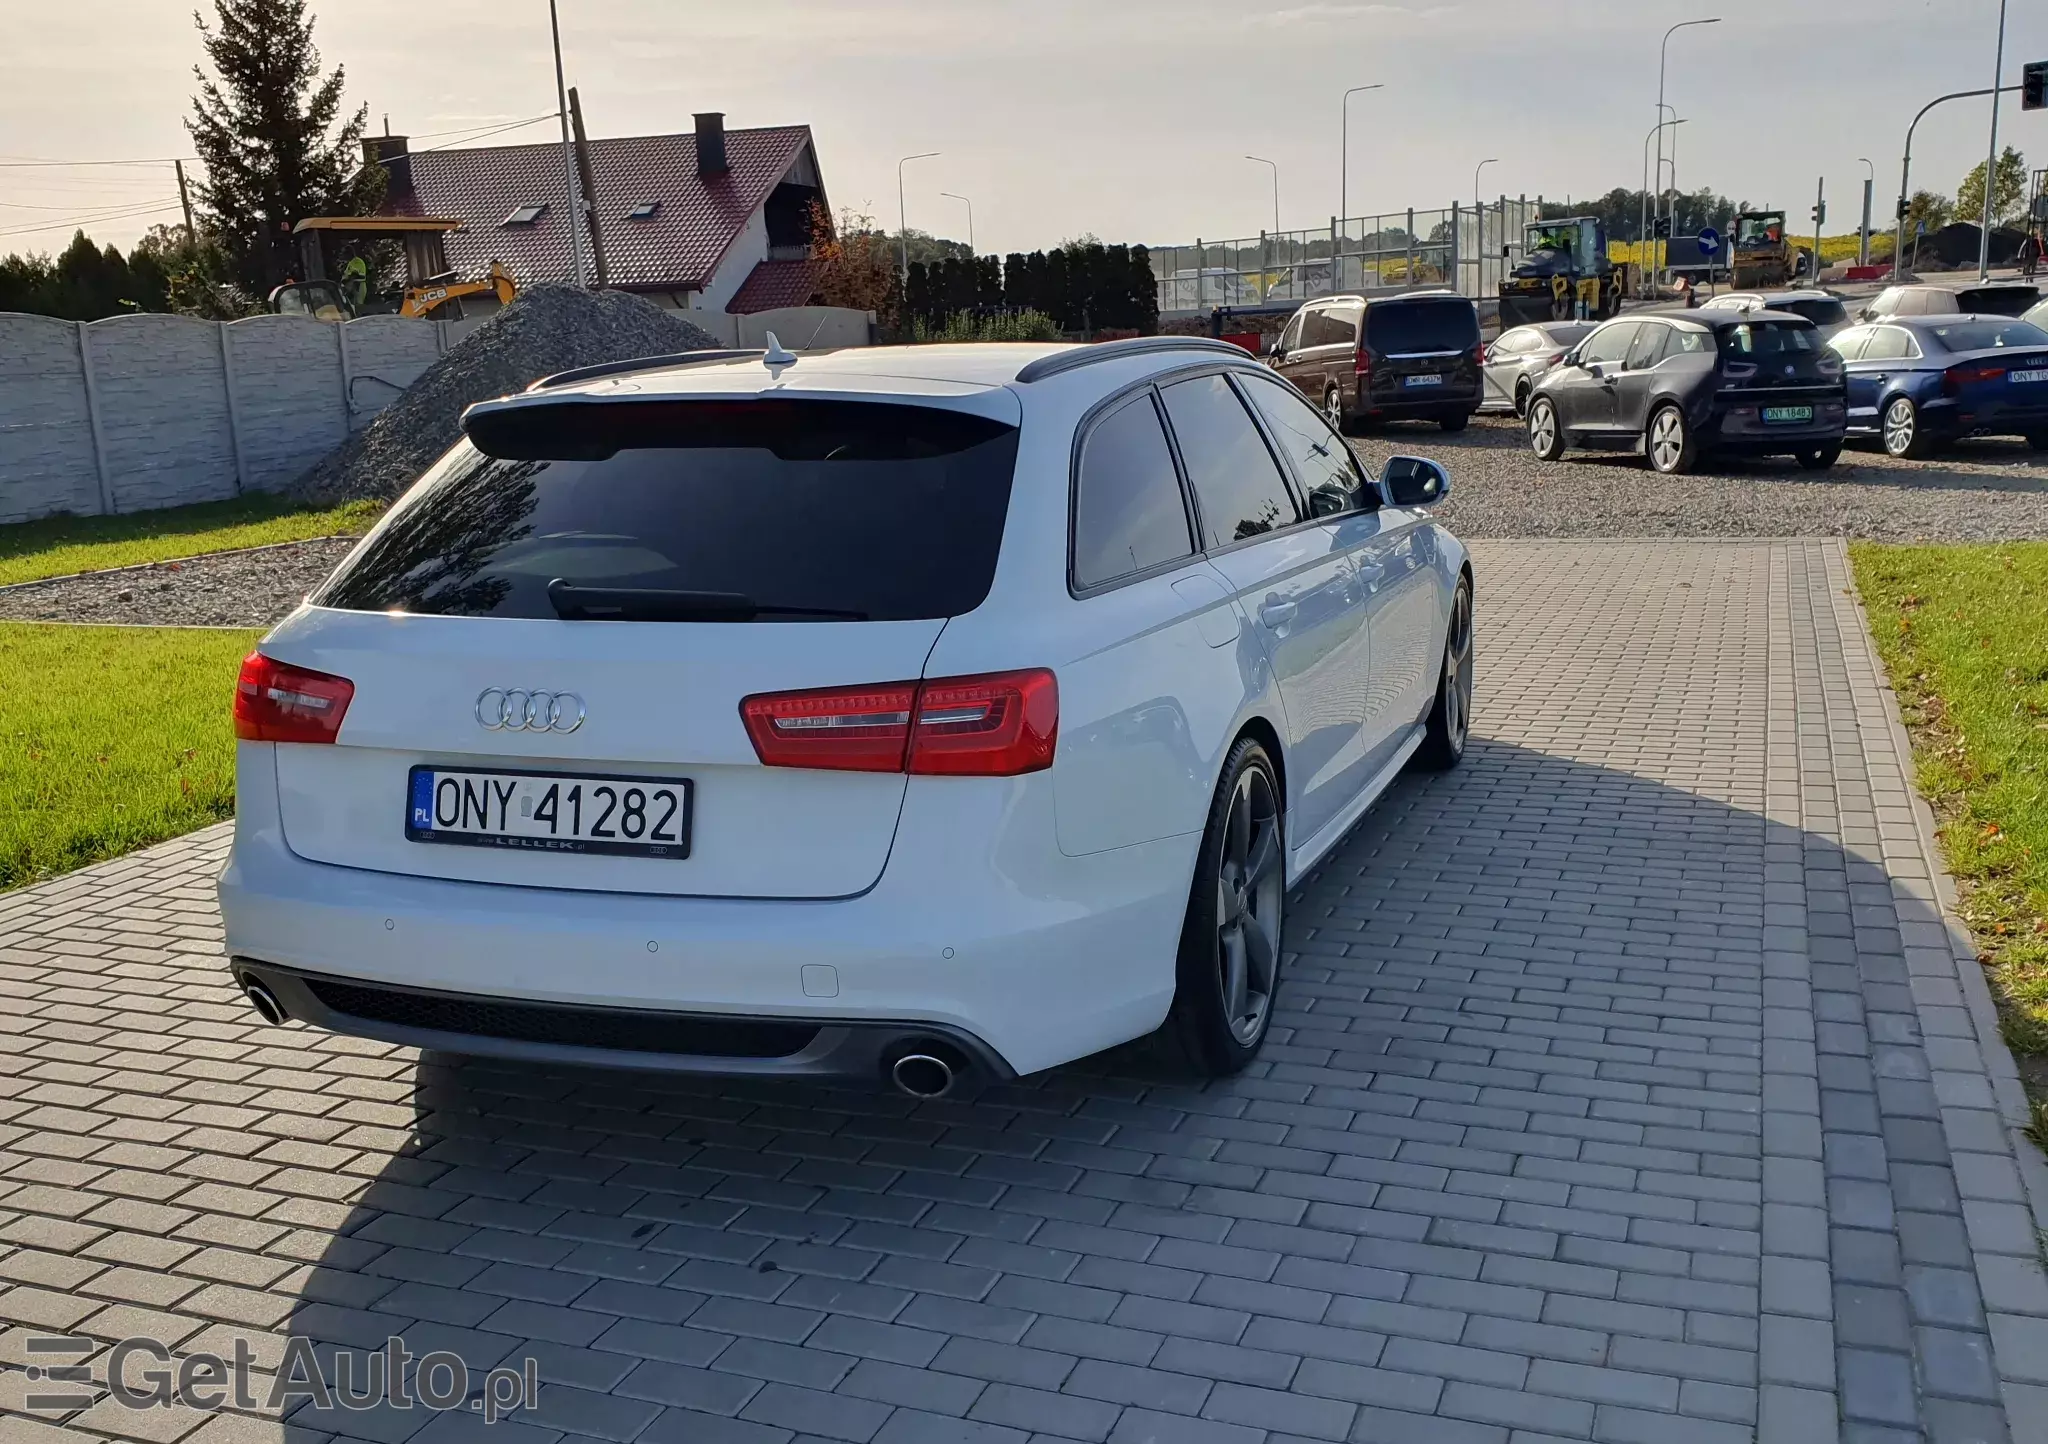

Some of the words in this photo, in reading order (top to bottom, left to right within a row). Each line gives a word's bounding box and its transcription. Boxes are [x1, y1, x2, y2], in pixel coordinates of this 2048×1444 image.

[420, 288, 447, 302] JCB
[2014, 372, 2032, 381] ONY
[1767, 409, 1782, 418] ONY
[415, 807, 430, 822] PL
[435, 777, 517, 831] ONY
[533, 783, 678, 841] 41282
